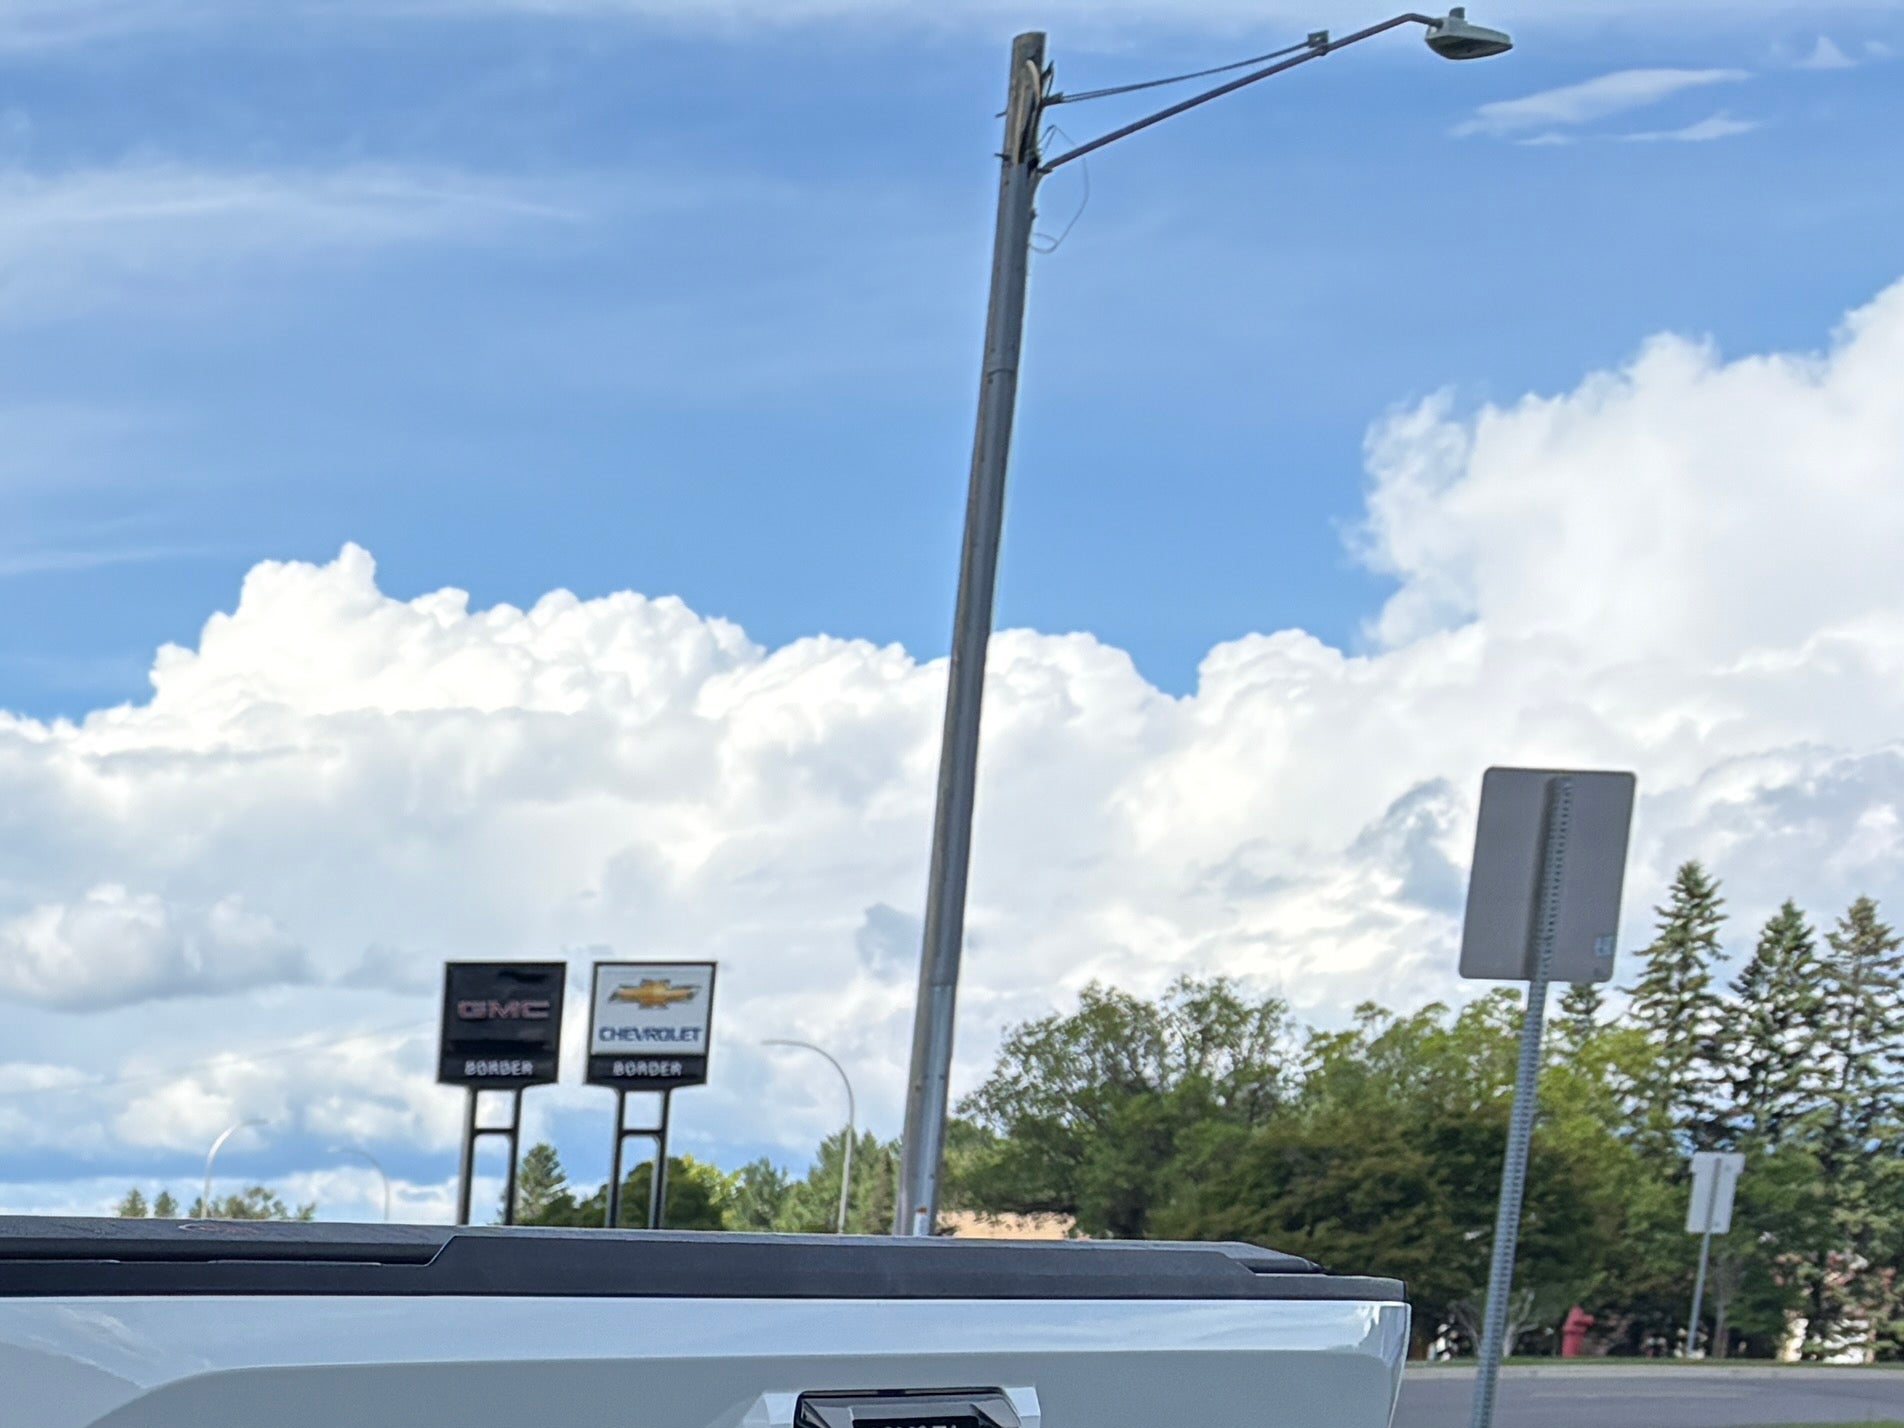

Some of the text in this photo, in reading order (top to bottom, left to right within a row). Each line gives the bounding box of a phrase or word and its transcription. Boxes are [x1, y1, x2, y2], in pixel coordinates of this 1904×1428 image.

[457, 1001, 550, 1019] GMC
[598, 1026, 702, 1042] CHEVROLET
[464, 1060, 533, 1076] BORDER
[612, 1060, 682, 1076] BORDER
